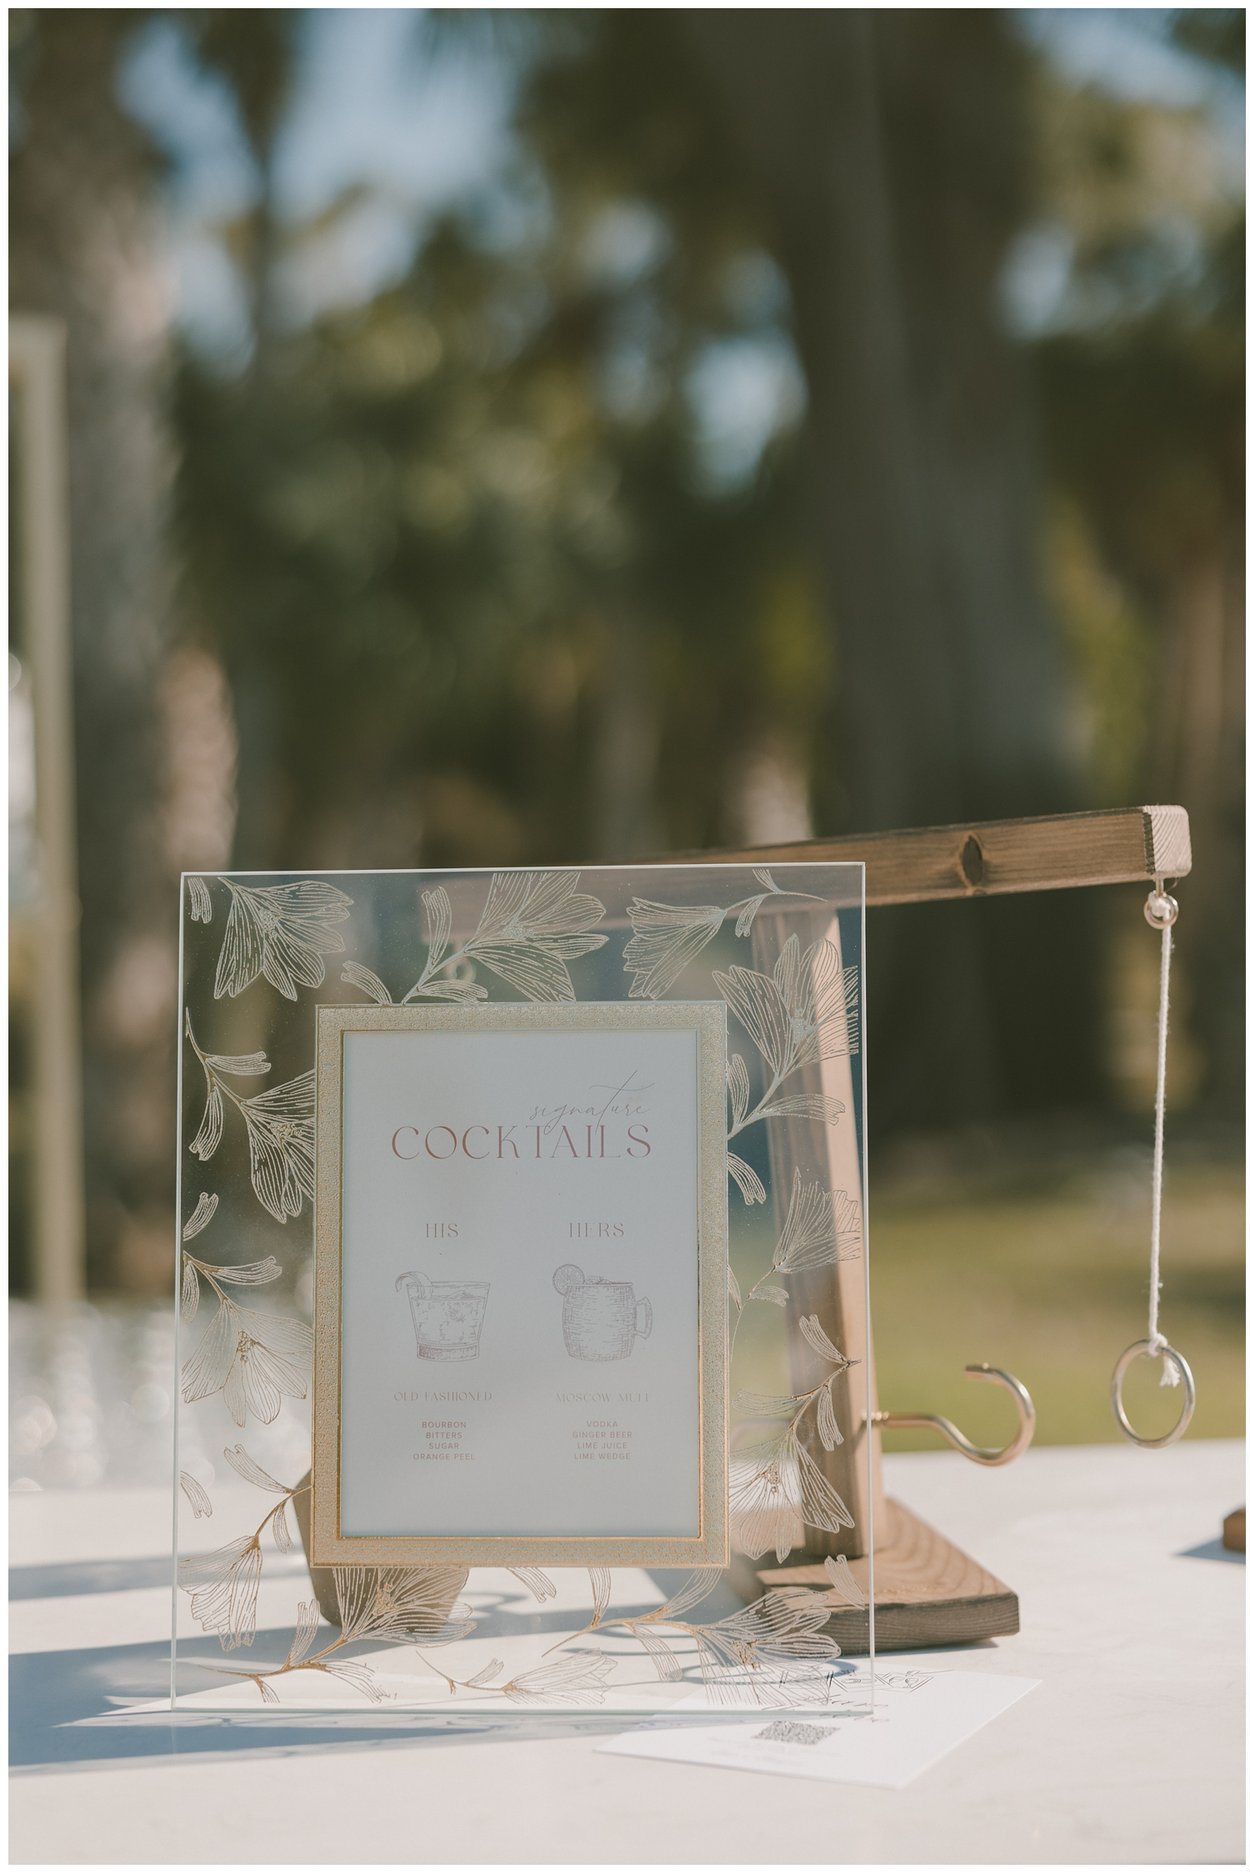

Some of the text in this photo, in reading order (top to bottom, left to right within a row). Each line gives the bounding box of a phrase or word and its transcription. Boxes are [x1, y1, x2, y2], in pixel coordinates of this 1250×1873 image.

[529, 1070, 656, 1135] signature
[391, 1124, 652, 1160] COCKTAILS
[425, 1223, 459, 1239] HIS
[569, 1222, 625, 1239] HERS
[394, 1391, 493, 1402] OLD FASHIONED
[556, 1391, 611, 1403] MOSCOW
[421, 1421, 467, 1429] BOURBON
[586, 1420, 618, 1428] VODKA
[425, 1431, 463, 1439] BITTERS
[572, 1431, 632, 1439] GINGER BEER
[428, 1442, 459, 1450] SUGAR
[577, 1441, 628, 1449] LIME JUICE
[412, 1453, 475, 1461] ORANGE PEEL
[574, 1452, 631, 1460] LIME WEDGE
